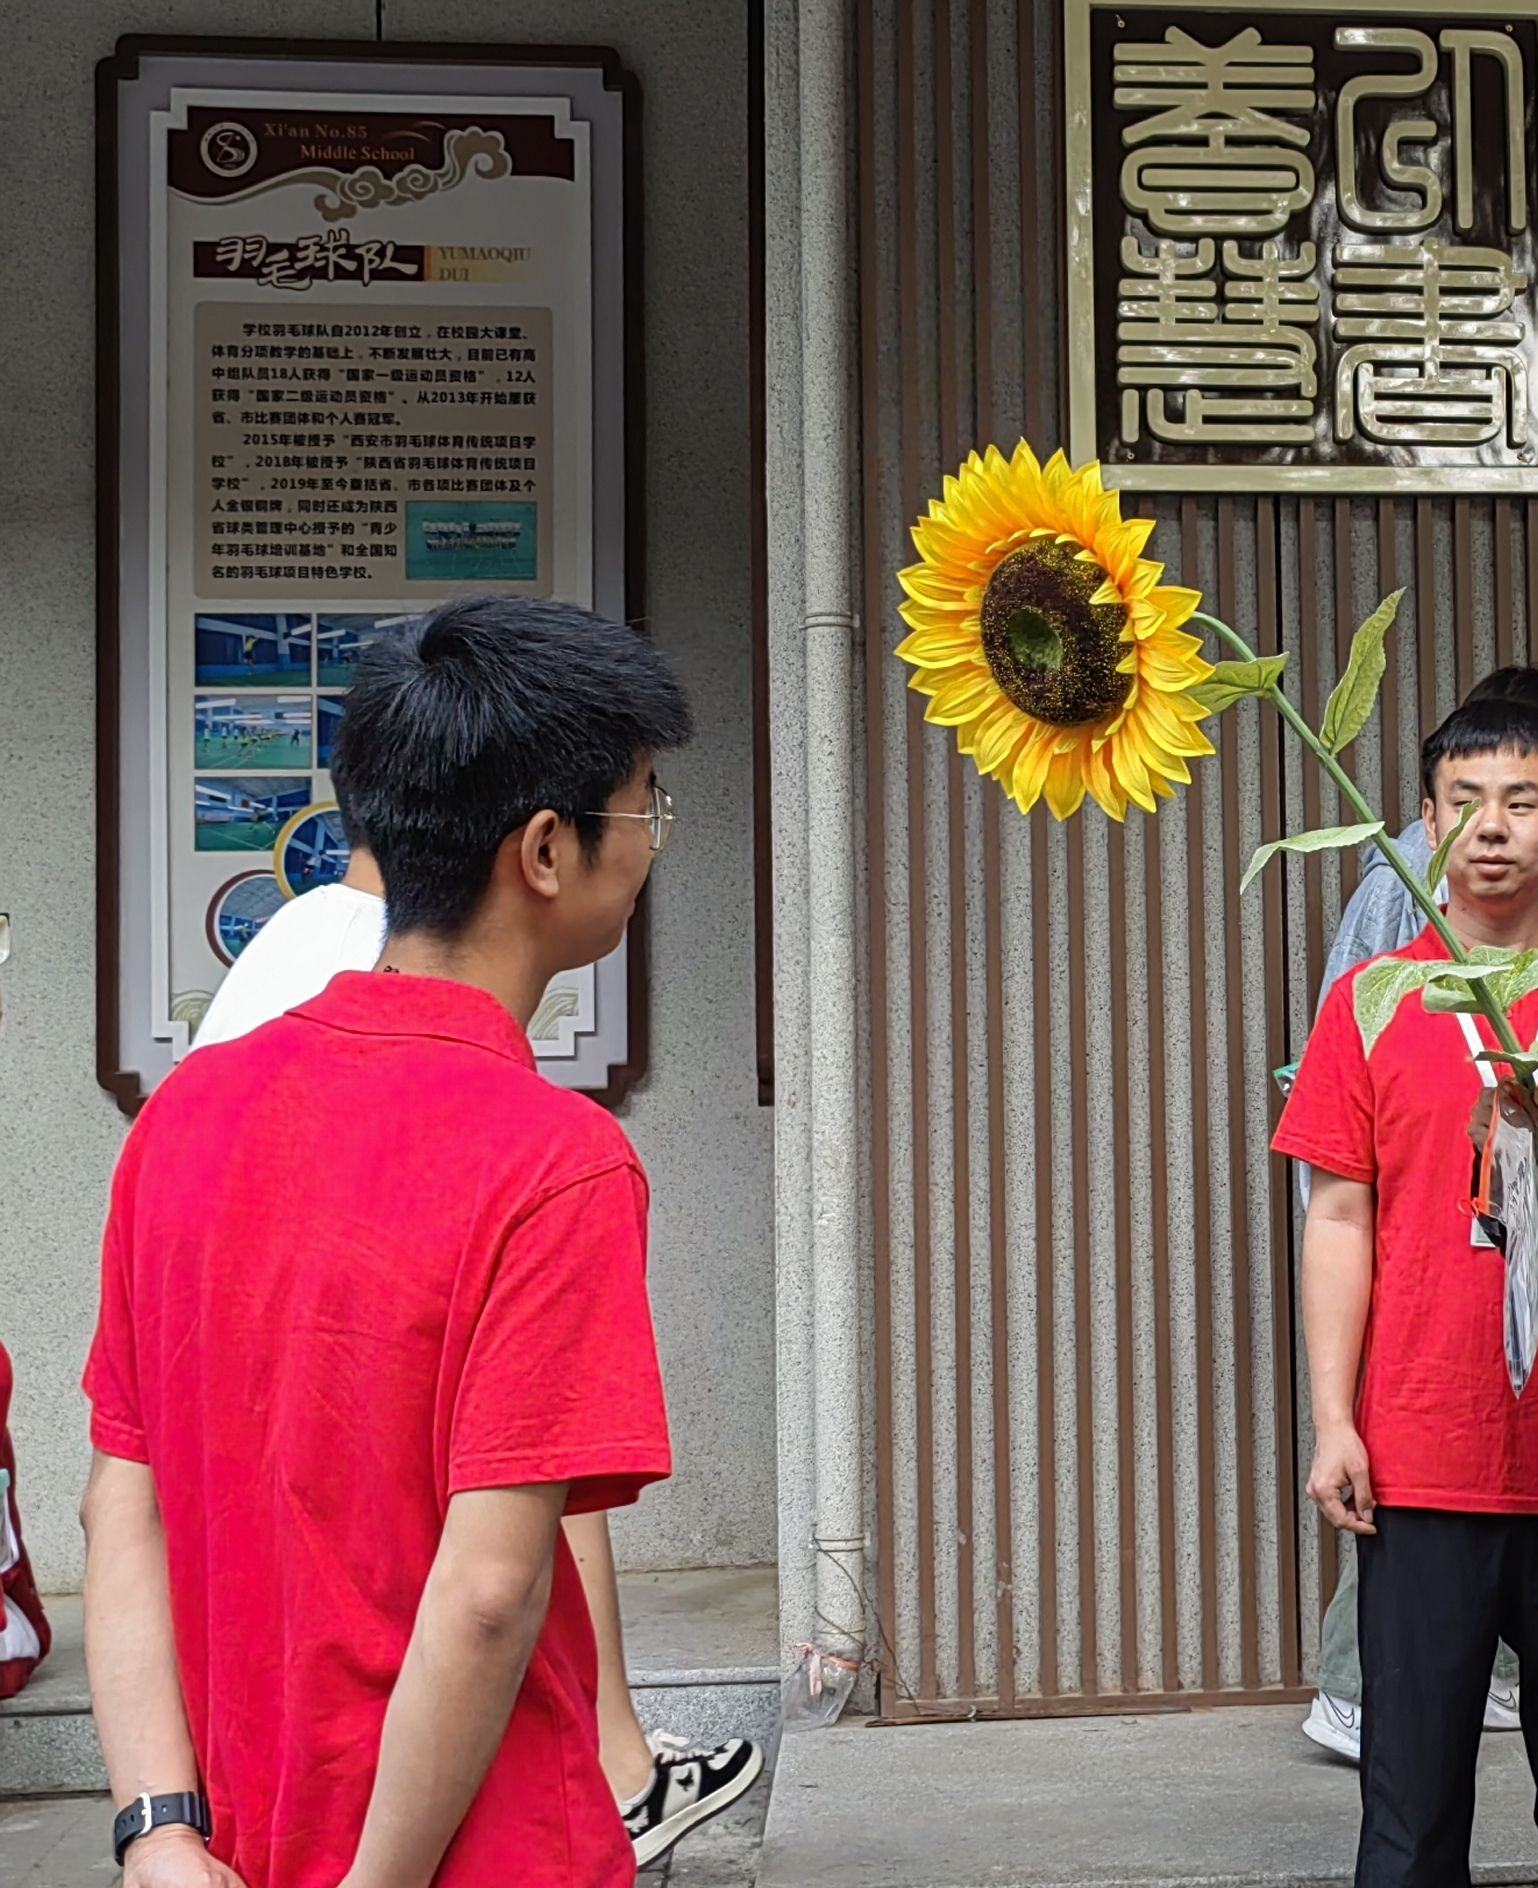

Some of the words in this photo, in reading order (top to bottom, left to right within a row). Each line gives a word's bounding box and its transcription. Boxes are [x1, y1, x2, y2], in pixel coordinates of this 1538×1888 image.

[316, 123, 368, 140] No.85
[301, 145, 357, 160] Middle
[362, 146, 416, 162] School
[216, 229, 417, 290] 羽毛球队
[440, 247, 531, 263] YUMAOQIU
[440, 267, 470, 282] DUI
